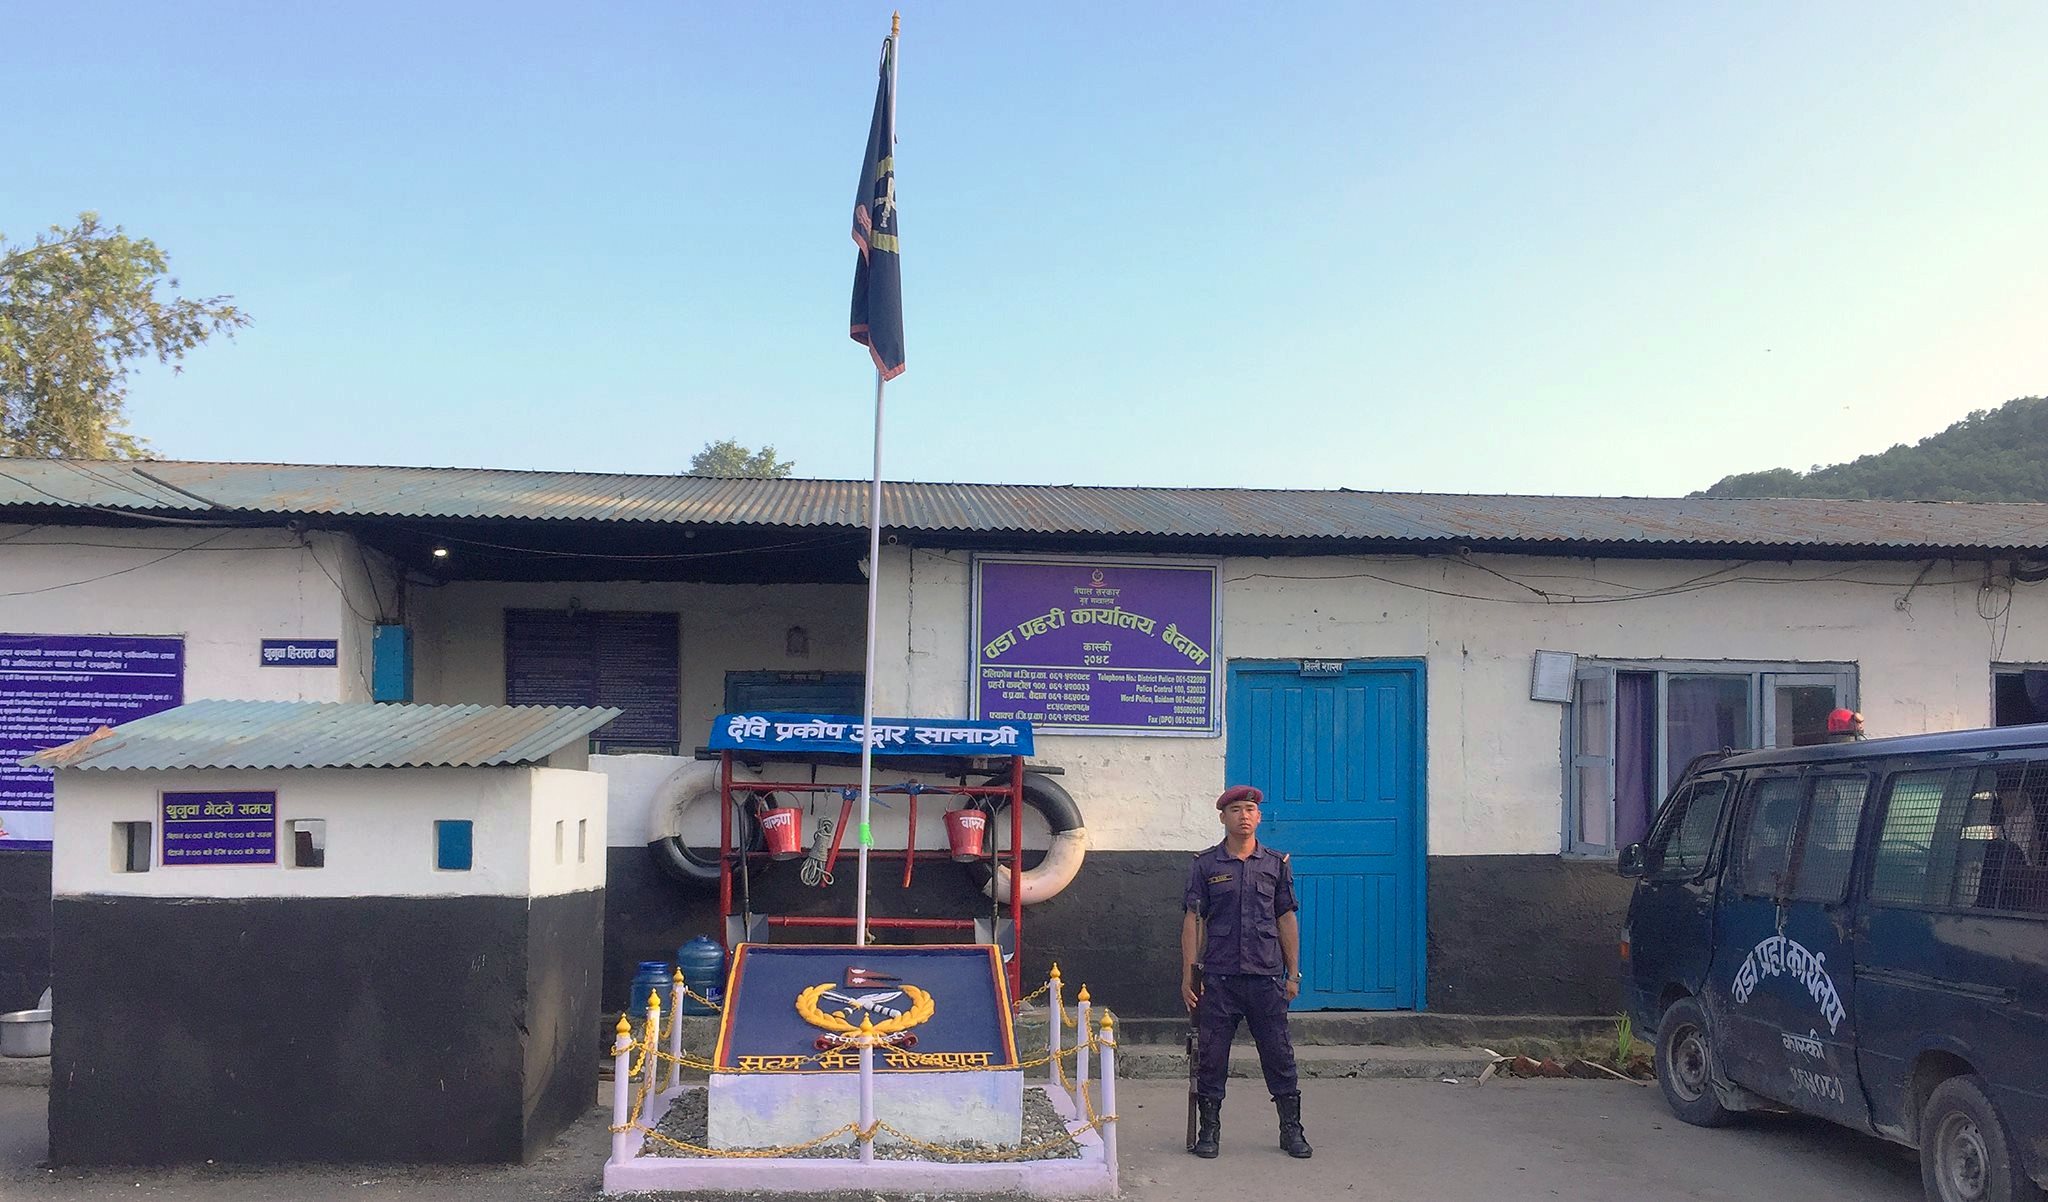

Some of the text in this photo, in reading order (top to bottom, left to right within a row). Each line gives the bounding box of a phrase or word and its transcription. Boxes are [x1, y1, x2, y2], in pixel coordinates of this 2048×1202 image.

[982, 630, 1018, 660] वडा
[1017, 607, 1066, 642] प्रहरी
[1161, 623, 1210, 666] बैदाम
[1082, 640, 1112, 652] कास्की
[1084, 655, 1110, 666] २०४८
[774, 719, 848, 742] प्रकोप
[914, 726, 1019, 747] सामाग्री
[238, 804, 272, 815] समय
[1732, 950, 1759, 1004] वडा
